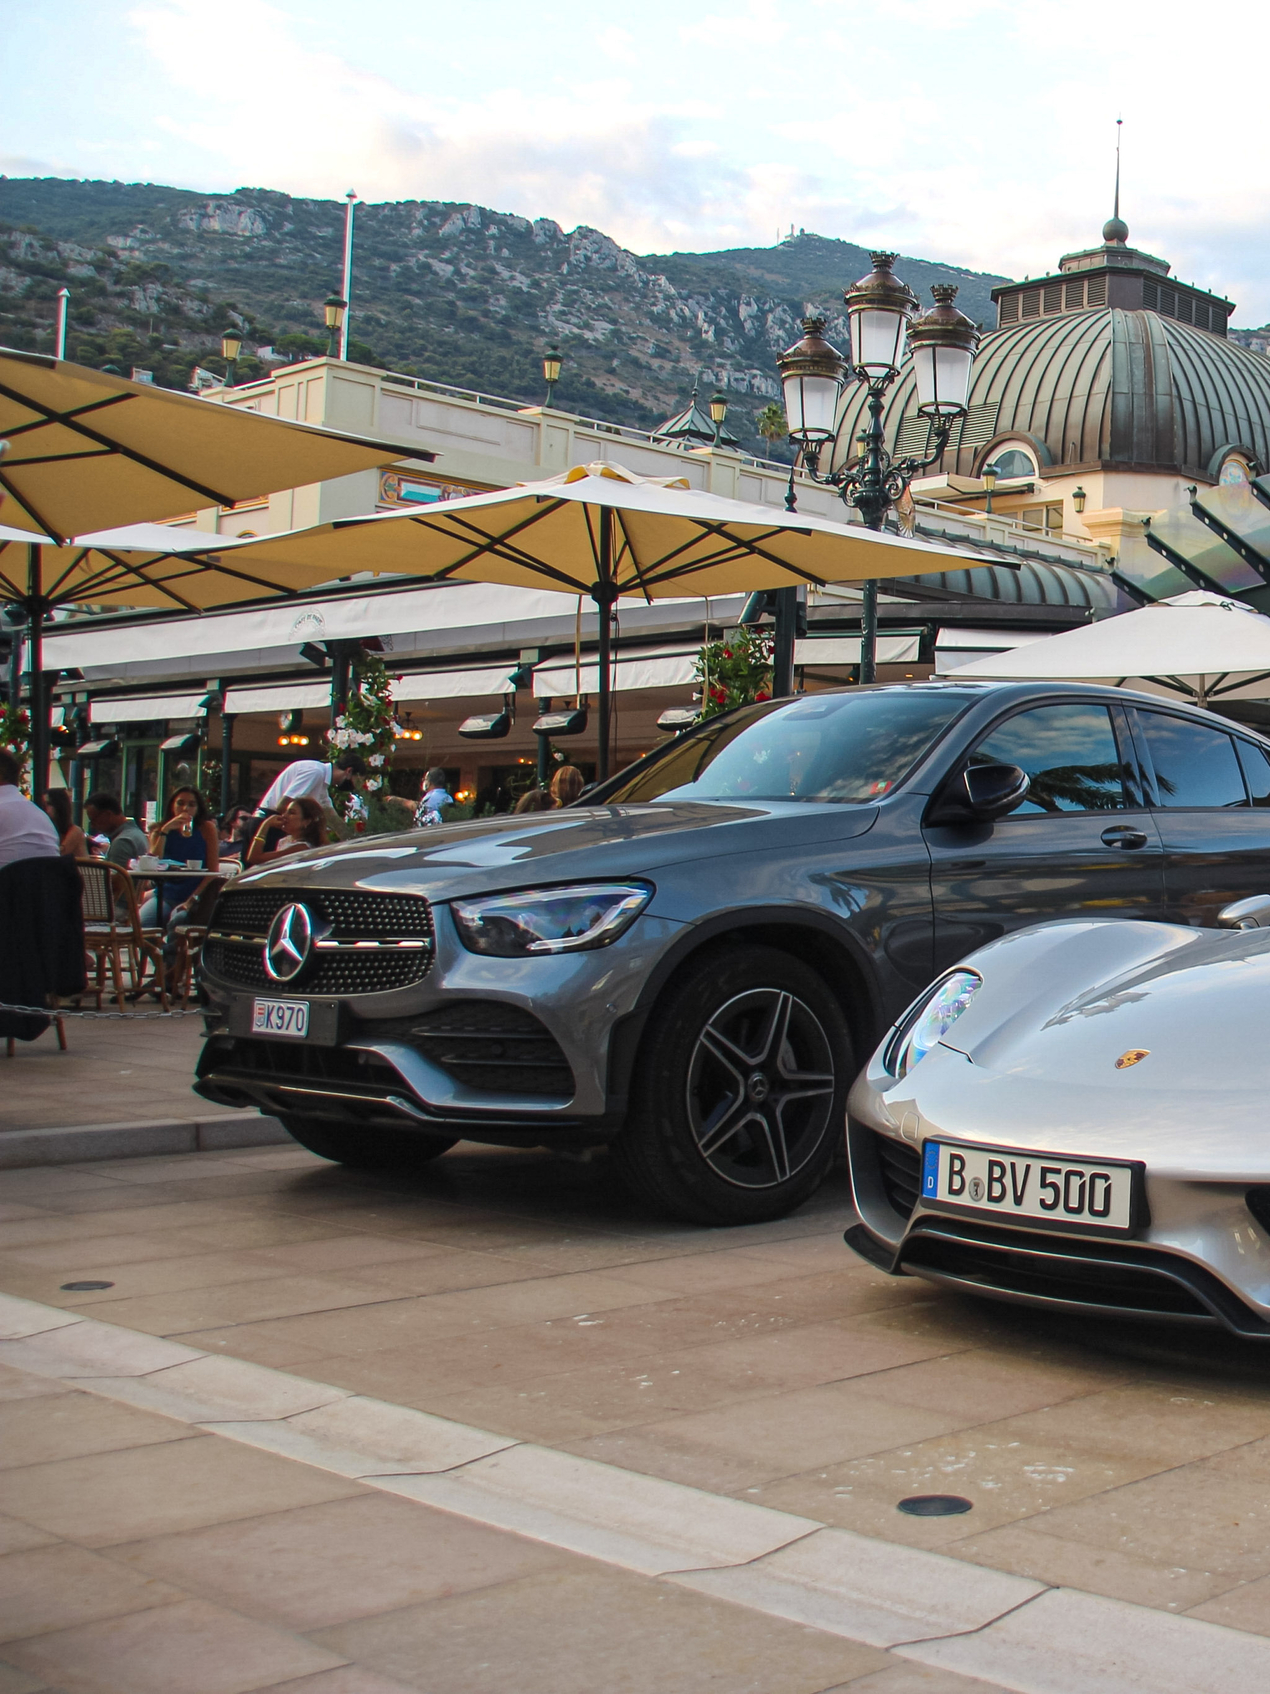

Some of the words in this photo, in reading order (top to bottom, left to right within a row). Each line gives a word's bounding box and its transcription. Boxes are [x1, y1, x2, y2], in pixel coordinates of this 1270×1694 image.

[266, 1004, 305, 1032] K970
[927, 1176, 934, 1189] D
[947, 1152, 966, 1196] B
[987, 1158, 1031, 1206] BV
[1039, 1165, 1112, 1218] 500
